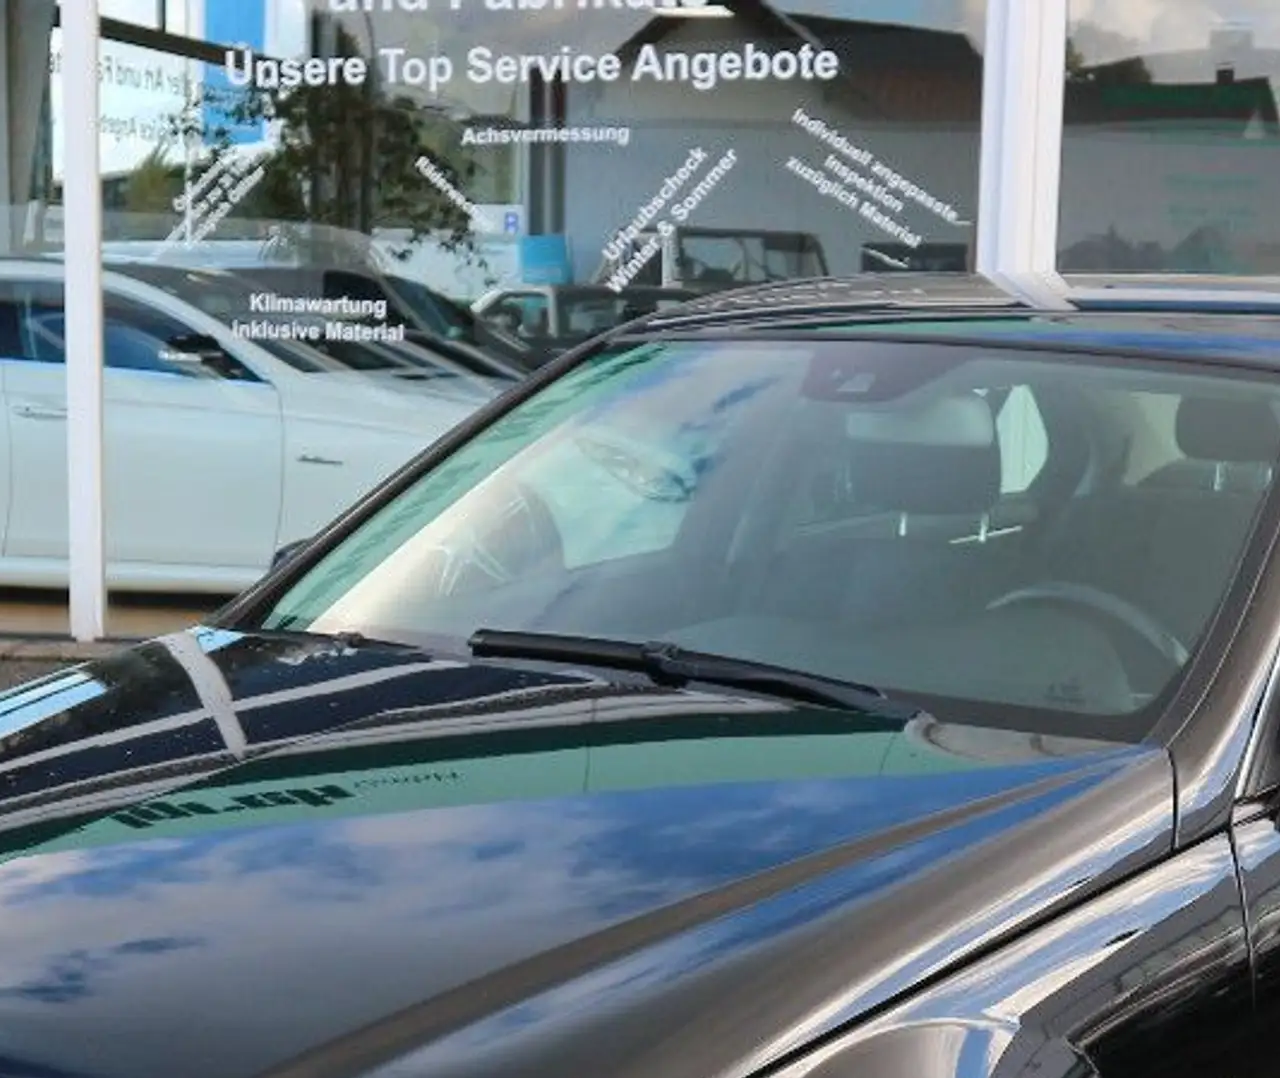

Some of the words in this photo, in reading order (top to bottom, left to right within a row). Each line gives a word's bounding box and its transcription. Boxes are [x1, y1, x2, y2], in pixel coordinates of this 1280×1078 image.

[224, 49, 368, 88] Unsere
[379, 48, 453, 92] Top
[467, 46, 621, 84] Service
[631, 43, 840, 90] Angebote
[461, 126, 630, 146] Achsvermessung
[605, 238, 661, 293] Winter
[671, 148, 738, 221] Sommer
[250, 293, 387, 319] Klimawartung
[325, 322, 404, 341] Material
